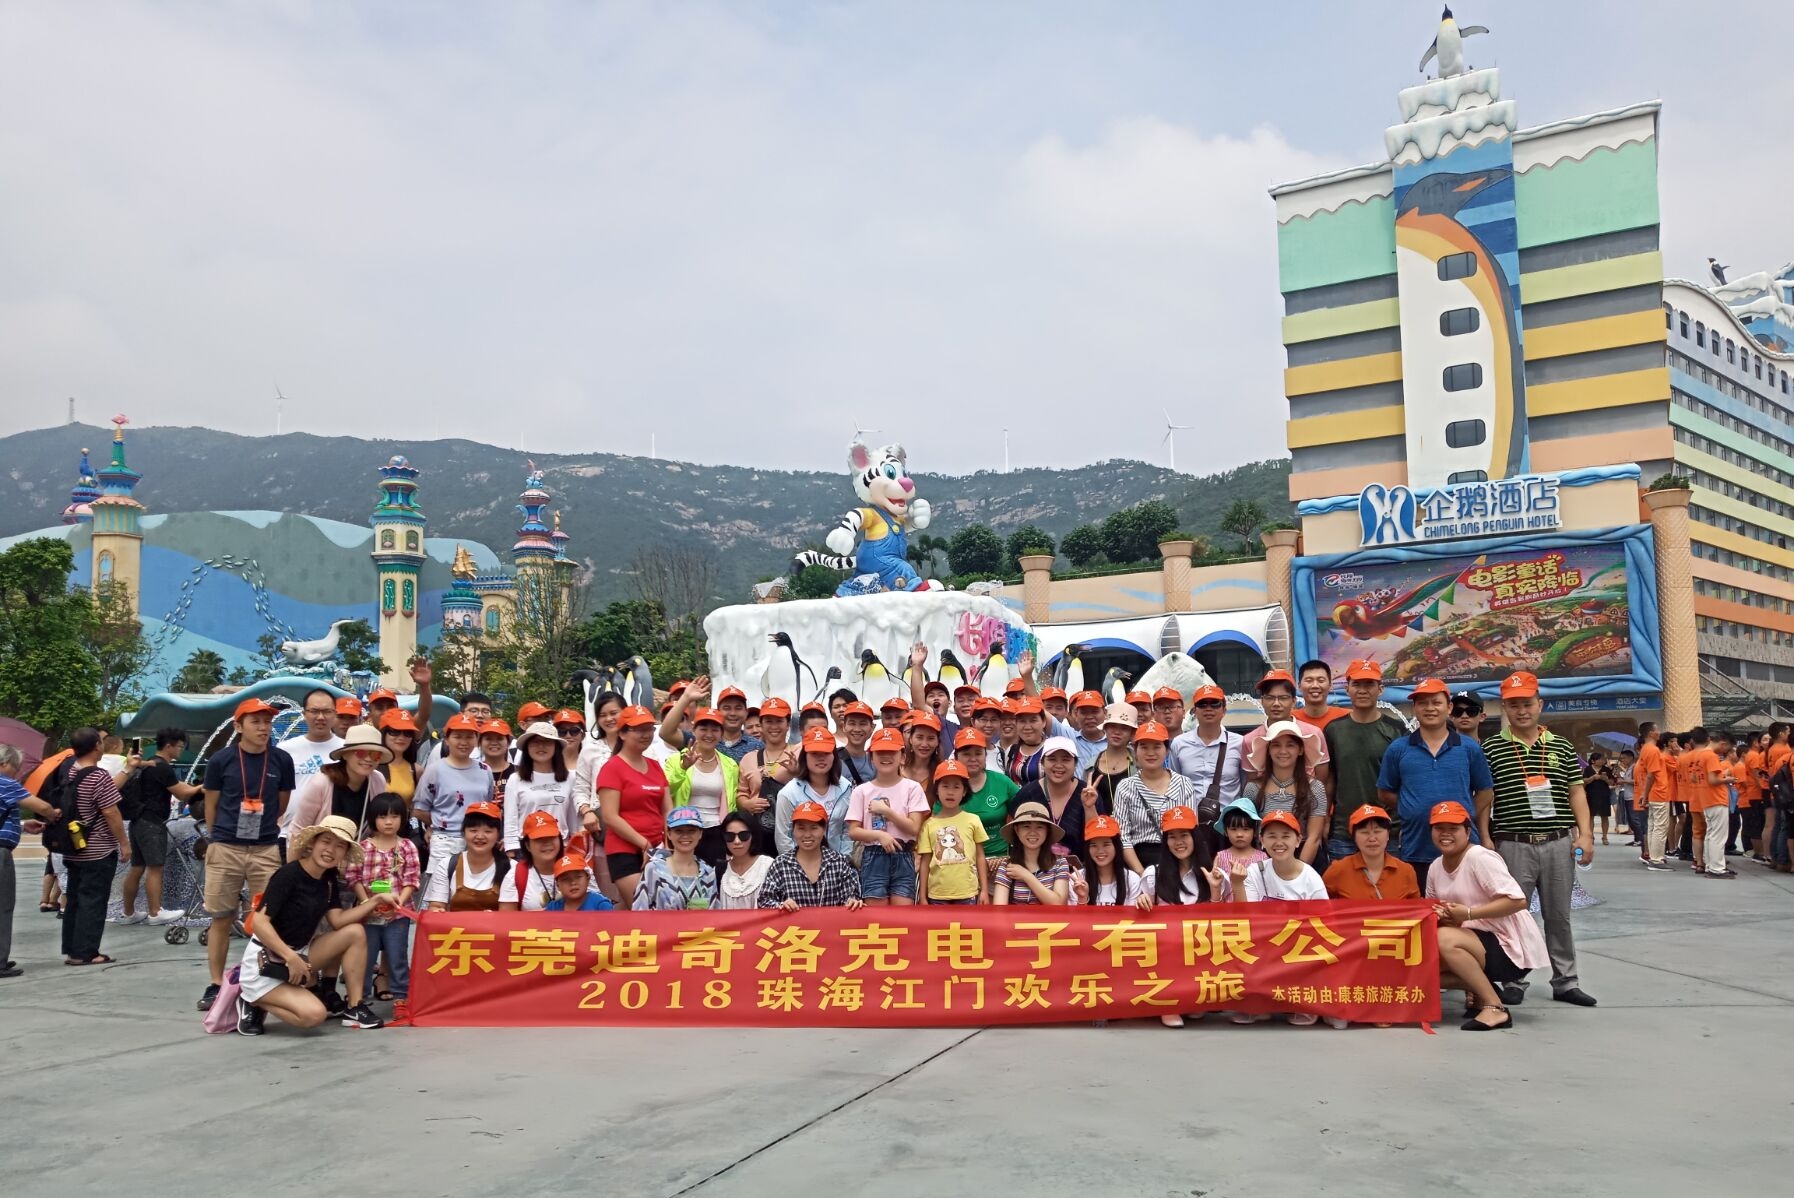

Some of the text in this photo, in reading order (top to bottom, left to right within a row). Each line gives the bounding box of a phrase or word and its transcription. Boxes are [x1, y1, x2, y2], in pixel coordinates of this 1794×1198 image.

[1423, 478, 1557, 522] 企鹅酒店
[1424, 514, 1559, 538] CHIMELONG PENGUIN HOTEL
[1468, 559, 1558, 588] 电影童话
[1495, 571, 1580, 599] 真实降临
[427, 918, 1424, 977] 东莞迪奇洛克电子有限公司
